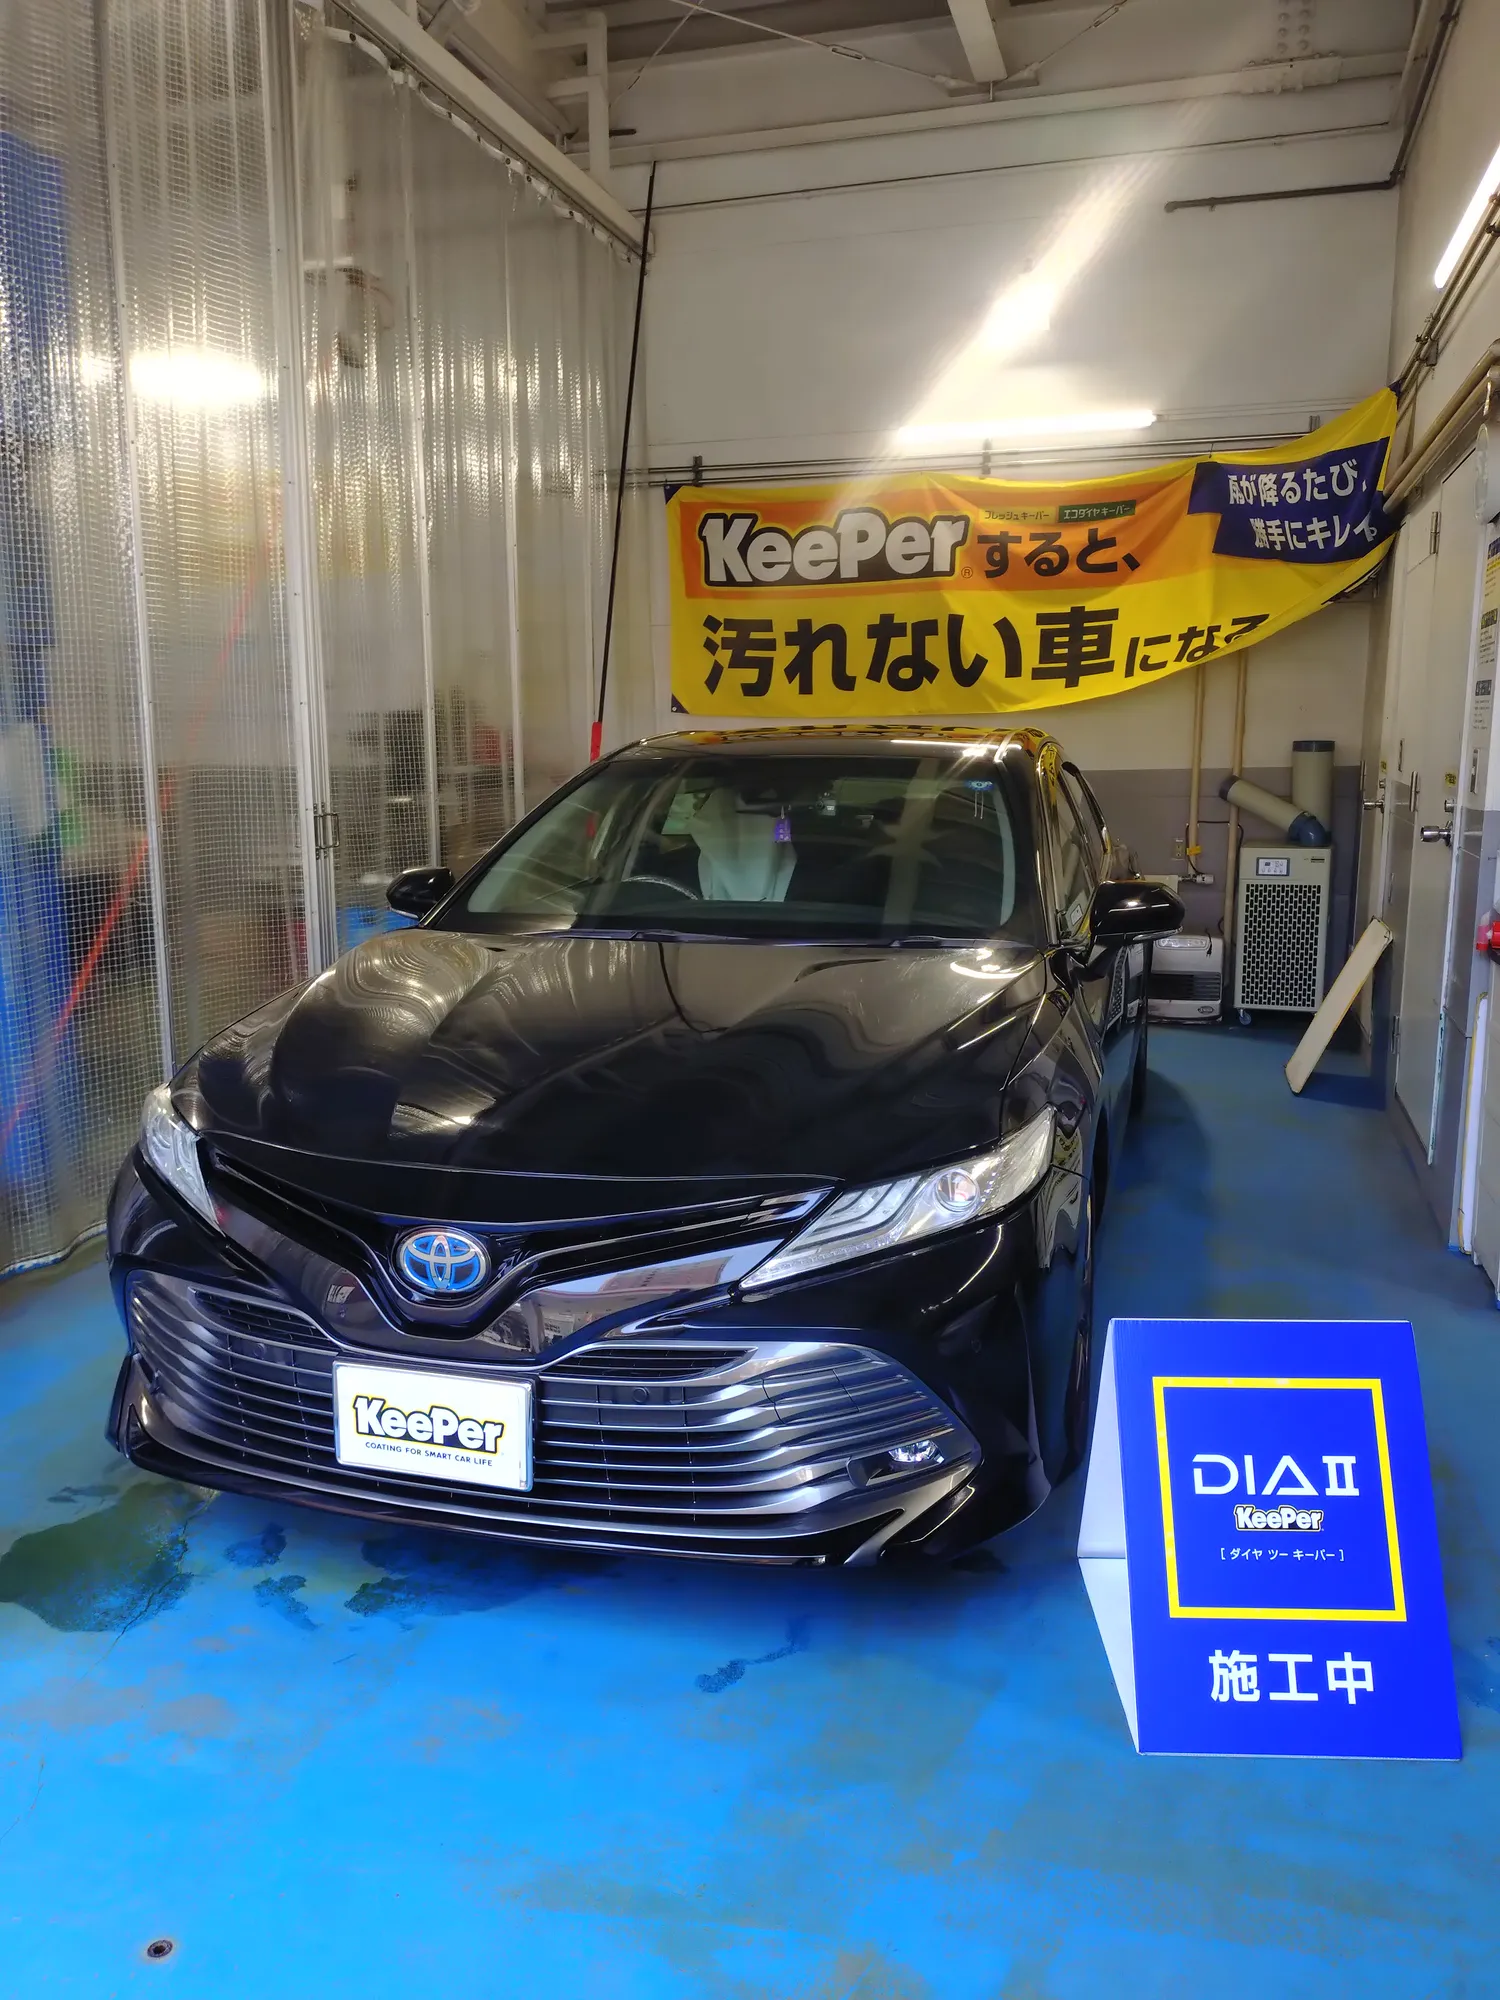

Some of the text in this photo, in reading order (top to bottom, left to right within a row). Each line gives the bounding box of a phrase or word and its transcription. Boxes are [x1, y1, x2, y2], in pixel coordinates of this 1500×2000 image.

[699, 508, 970, 586] KeePer
[352, 1394, 505, 1454] KeePer
[365, 1441, 493, 1467] COATING FOR SMART CAR LIFE
[1234, 1504, 1324, 1532] KeePer
[1208, 1649, 1375, 1705] 施工中
